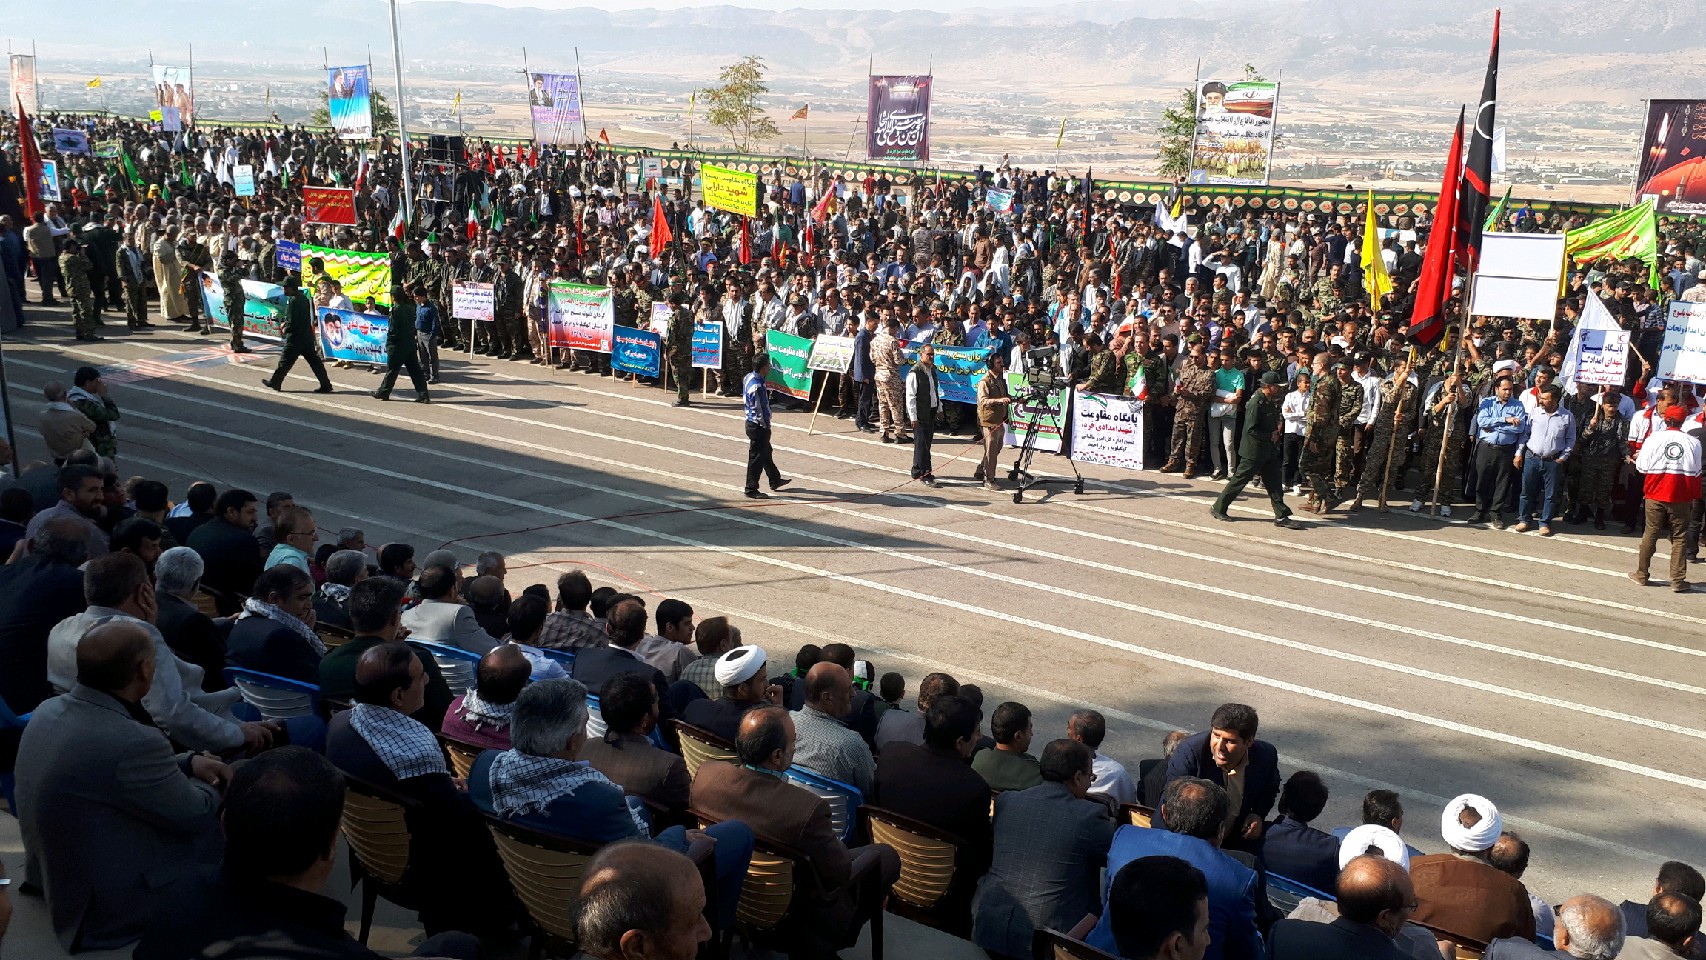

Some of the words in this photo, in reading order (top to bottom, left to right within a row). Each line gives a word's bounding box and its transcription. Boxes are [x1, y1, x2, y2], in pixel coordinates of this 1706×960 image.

[726, 186, 748, 197] شهید
[694, 325, 718, 335] پایگاه
[692, 336, 718, 344] مقاومت
[779, 345, 797, 357] مقاومت
[1582, 344, 1603, 354] بسیج
[1605, 344, 1623, 355] پایگاه
[797, 349, 808, 360] پایگاه
[1579, 356, 1604, 365] امدادگر
[1605, 357, 1622, 367] شهدای
[1081, 409, 1111, 421] مقاومت
[1114, 412, 1137, 427] پایگاه
[1117, 425, 1132, 434] شهید
